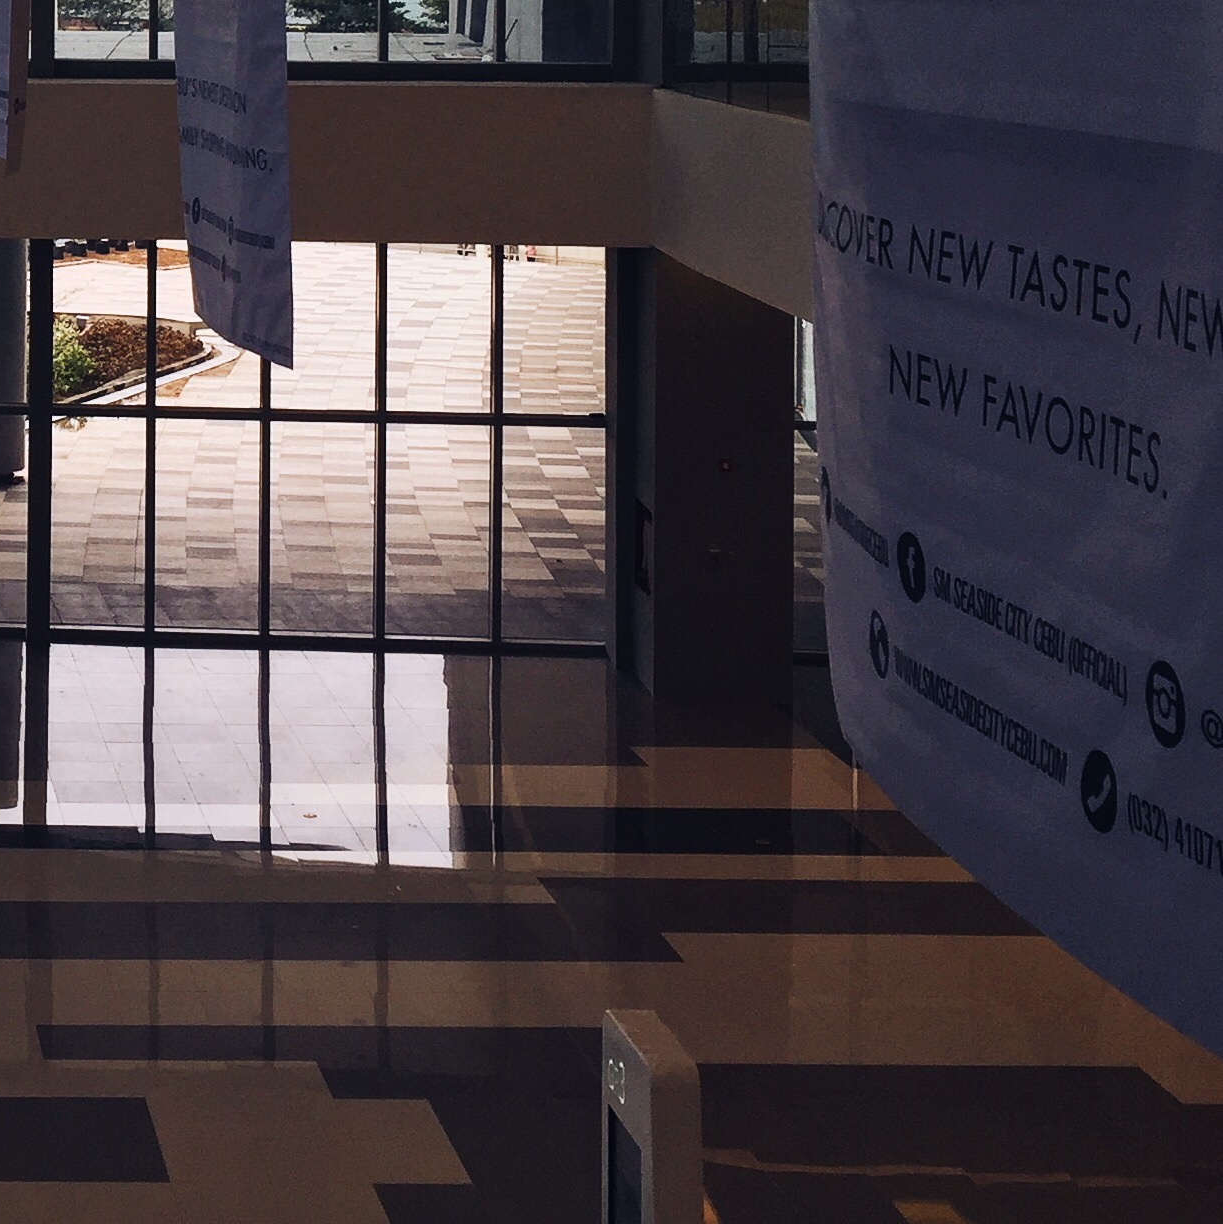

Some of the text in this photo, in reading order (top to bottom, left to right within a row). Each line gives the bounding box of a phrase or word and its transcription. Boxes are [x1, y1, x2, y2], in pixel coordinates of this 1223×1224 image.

[908, 224, 994, 291] NEW
[1008, 244, 1142, 345] TASTES,
[889, 343, 1168, 501] NEW FAVORITES.
[933, 566, 951, 604] SM
[954, 577, 1003, 630] SEASIDE
[1005, 602, 1033, 645] CITY
[1033, 617, 1065, 664] CEBU
[1128, 792, 1169, 852] (032)
